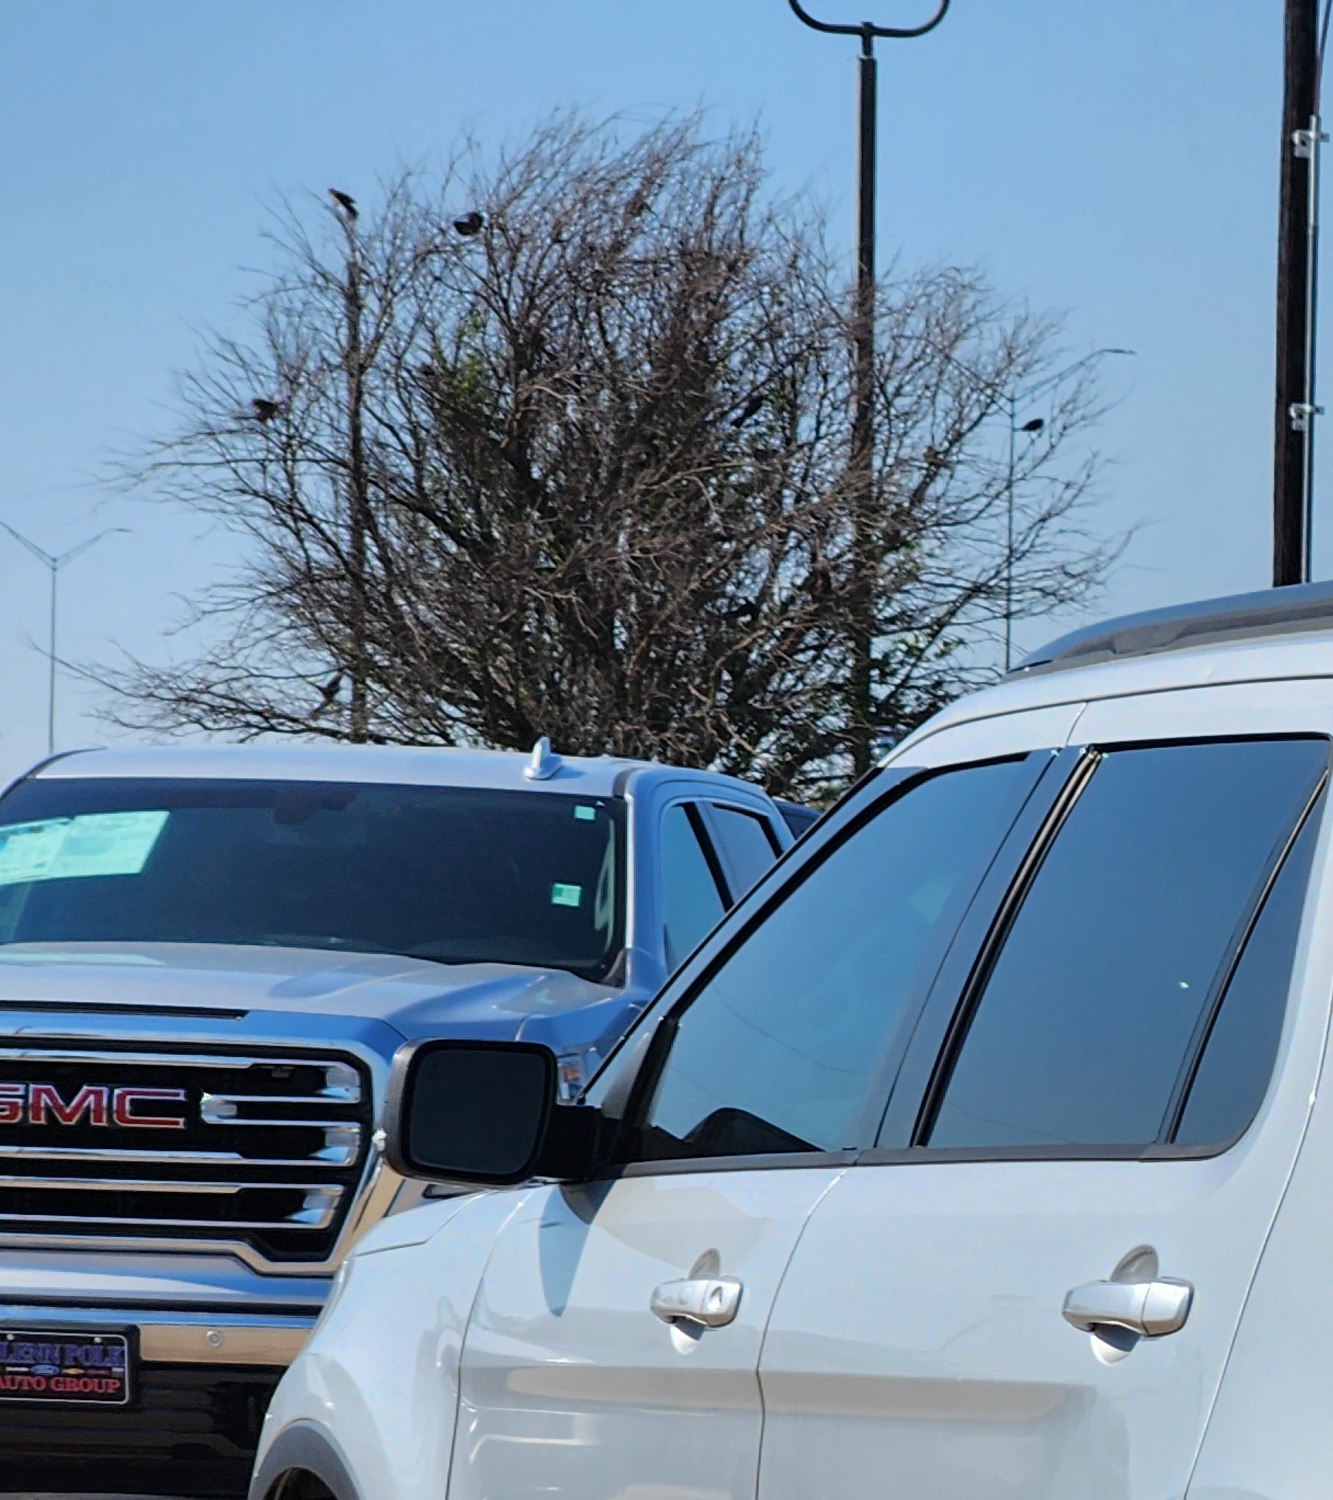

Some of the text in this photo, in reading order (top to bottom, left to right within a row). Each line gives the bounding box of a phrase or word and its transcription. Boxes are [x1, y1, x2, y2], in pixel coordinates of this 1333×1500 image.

[0, 1341, 125, 1367] LENN POLK
[49, 1377, 121, 1393] GROUP
